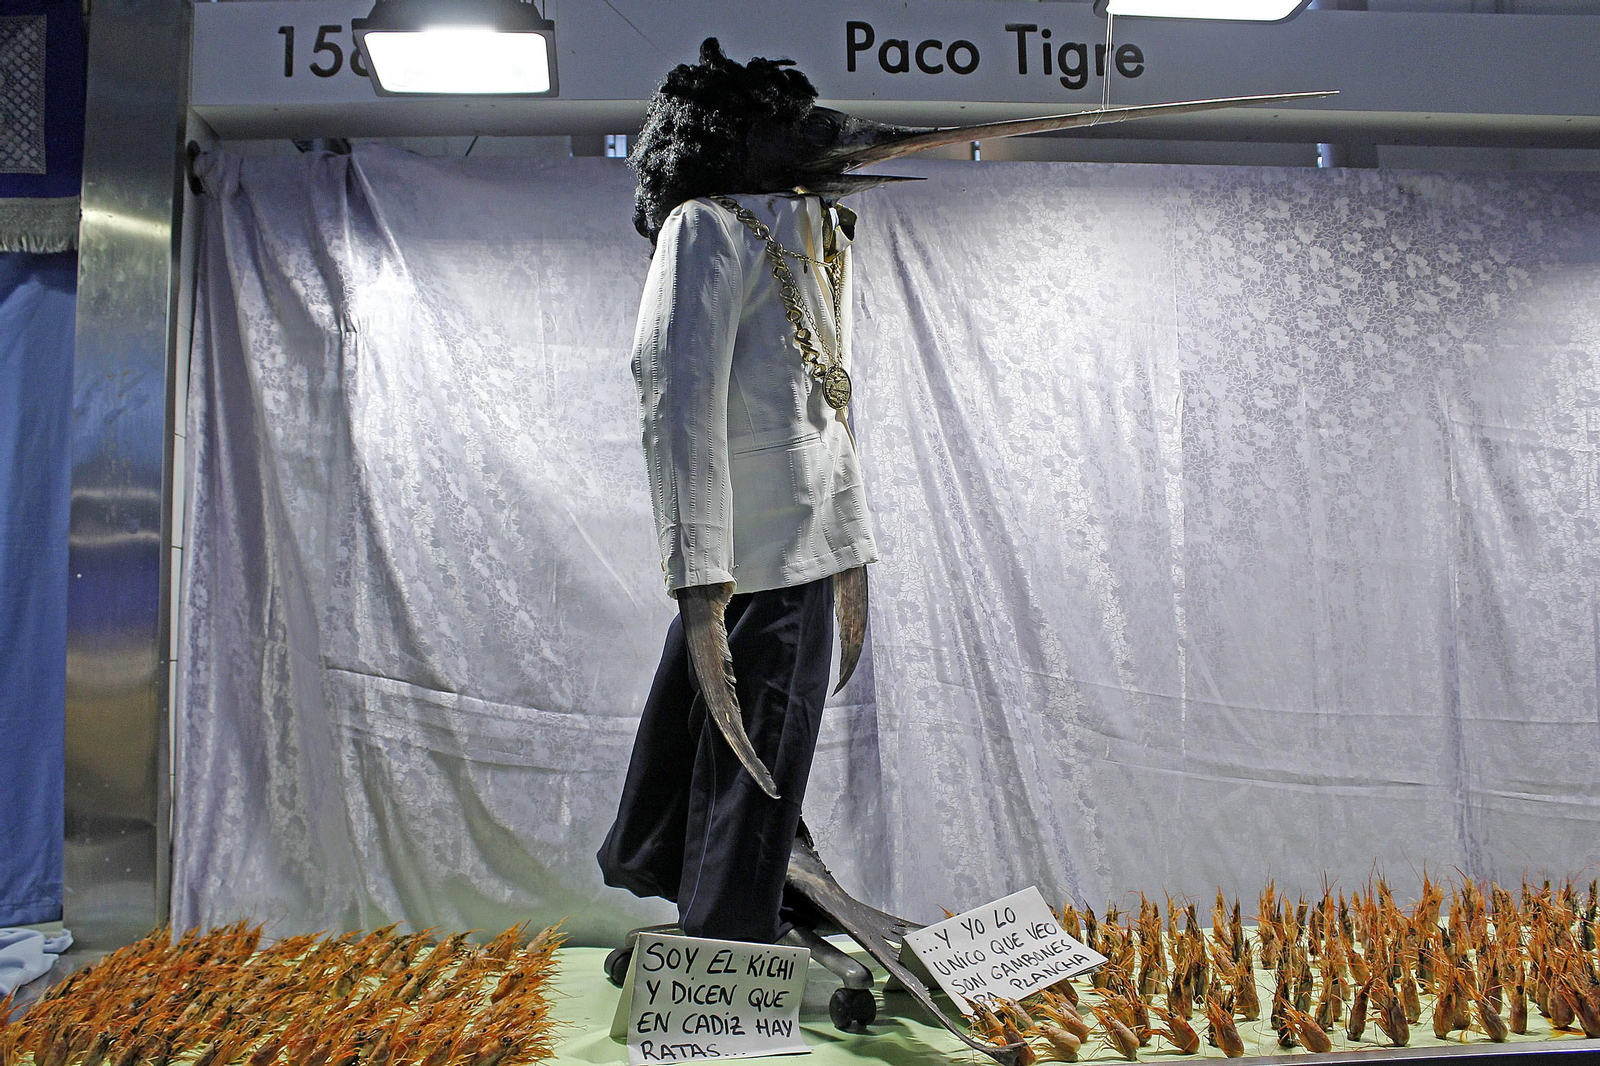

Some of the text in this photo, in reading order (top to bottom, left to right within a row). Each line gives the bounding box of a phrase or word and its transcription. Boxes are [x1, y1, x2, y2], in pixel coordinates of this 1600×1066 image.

[846, 21, 1145, 90] Paco Tigre
[960, 918, 986, 940] YO
[993, 906, 1016, 928] LO
[990, 932, 1025, 955] QUE
[1025, 922, 1057, 940] VEO
[642, 942, 699, 974] SOY
[706, 949, 738, 974] EL
[951, 939, 1073, 995] SON GAMBONES
[1009, 953, 1090, 991] PLANCHA
[646, 979, 661, 1006] Y
[748, 987, 790, 1013] QUE
[636, 1011, 672, 1034] EN
[756, 1018, 793, 1038] HAY
